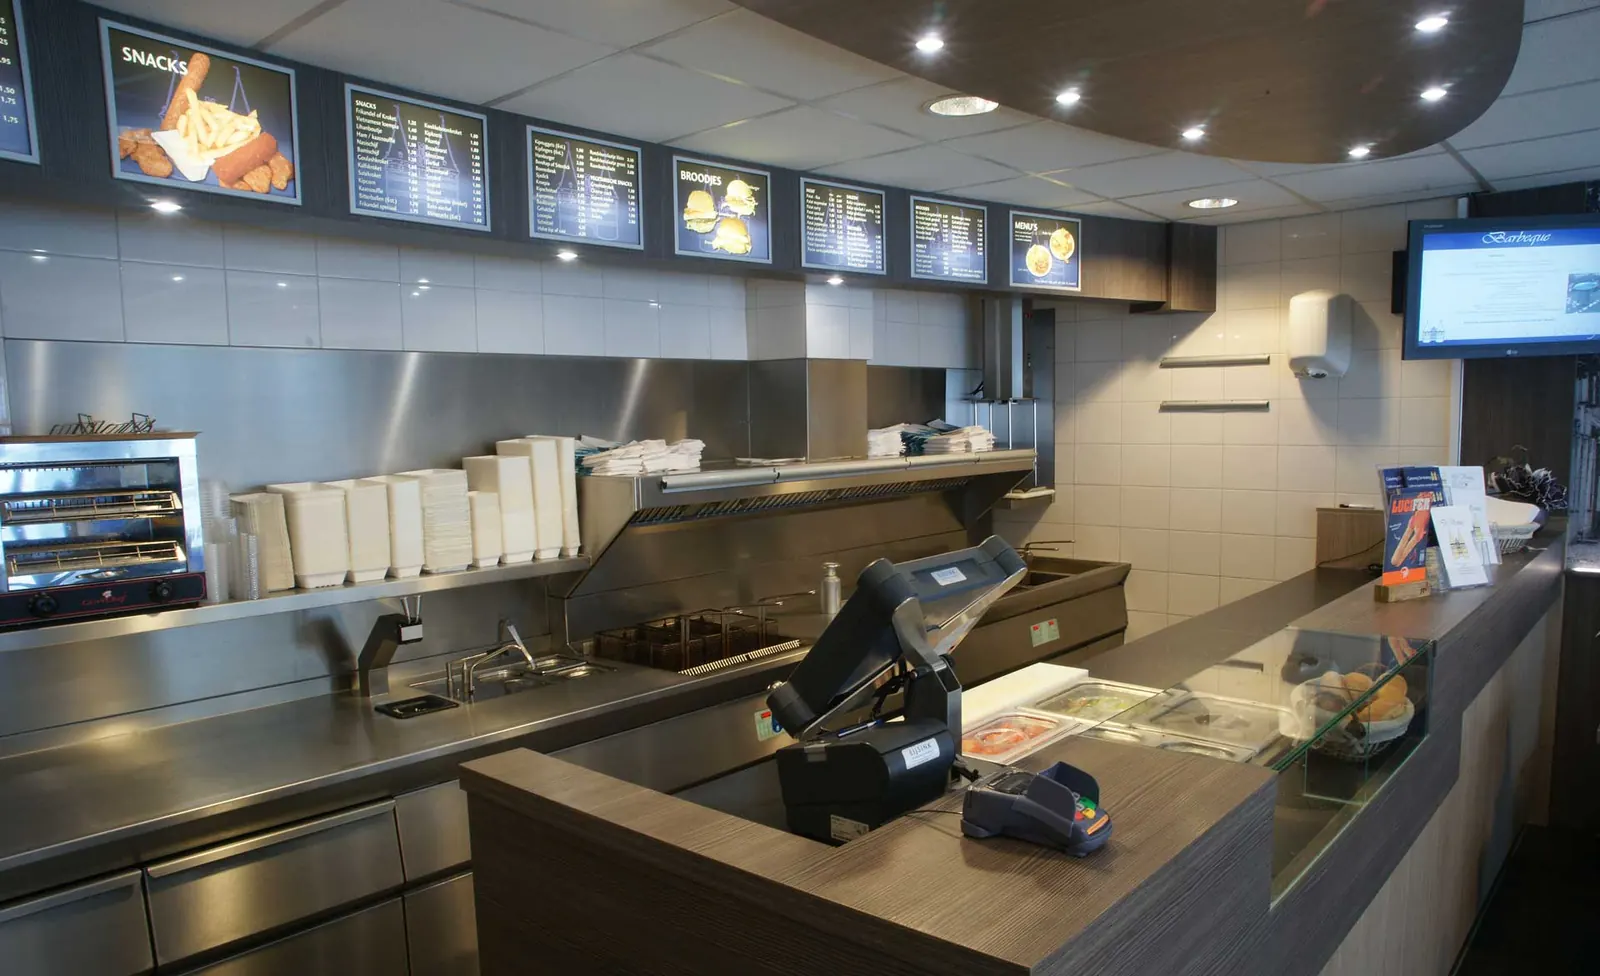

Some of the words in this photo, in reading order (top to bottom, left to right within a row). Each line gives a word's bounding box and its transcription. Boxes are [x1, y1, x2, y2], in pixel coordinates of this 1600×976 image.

[122, 46, 188, 76] SNACKS
[680, 170, 722, 186] BROODJES
[1015, 222, 1038, 231] MENU'S
[1482, 231, 1551, 246] Barbeque
[1392, 498, 1430, 514] LUCIFER
